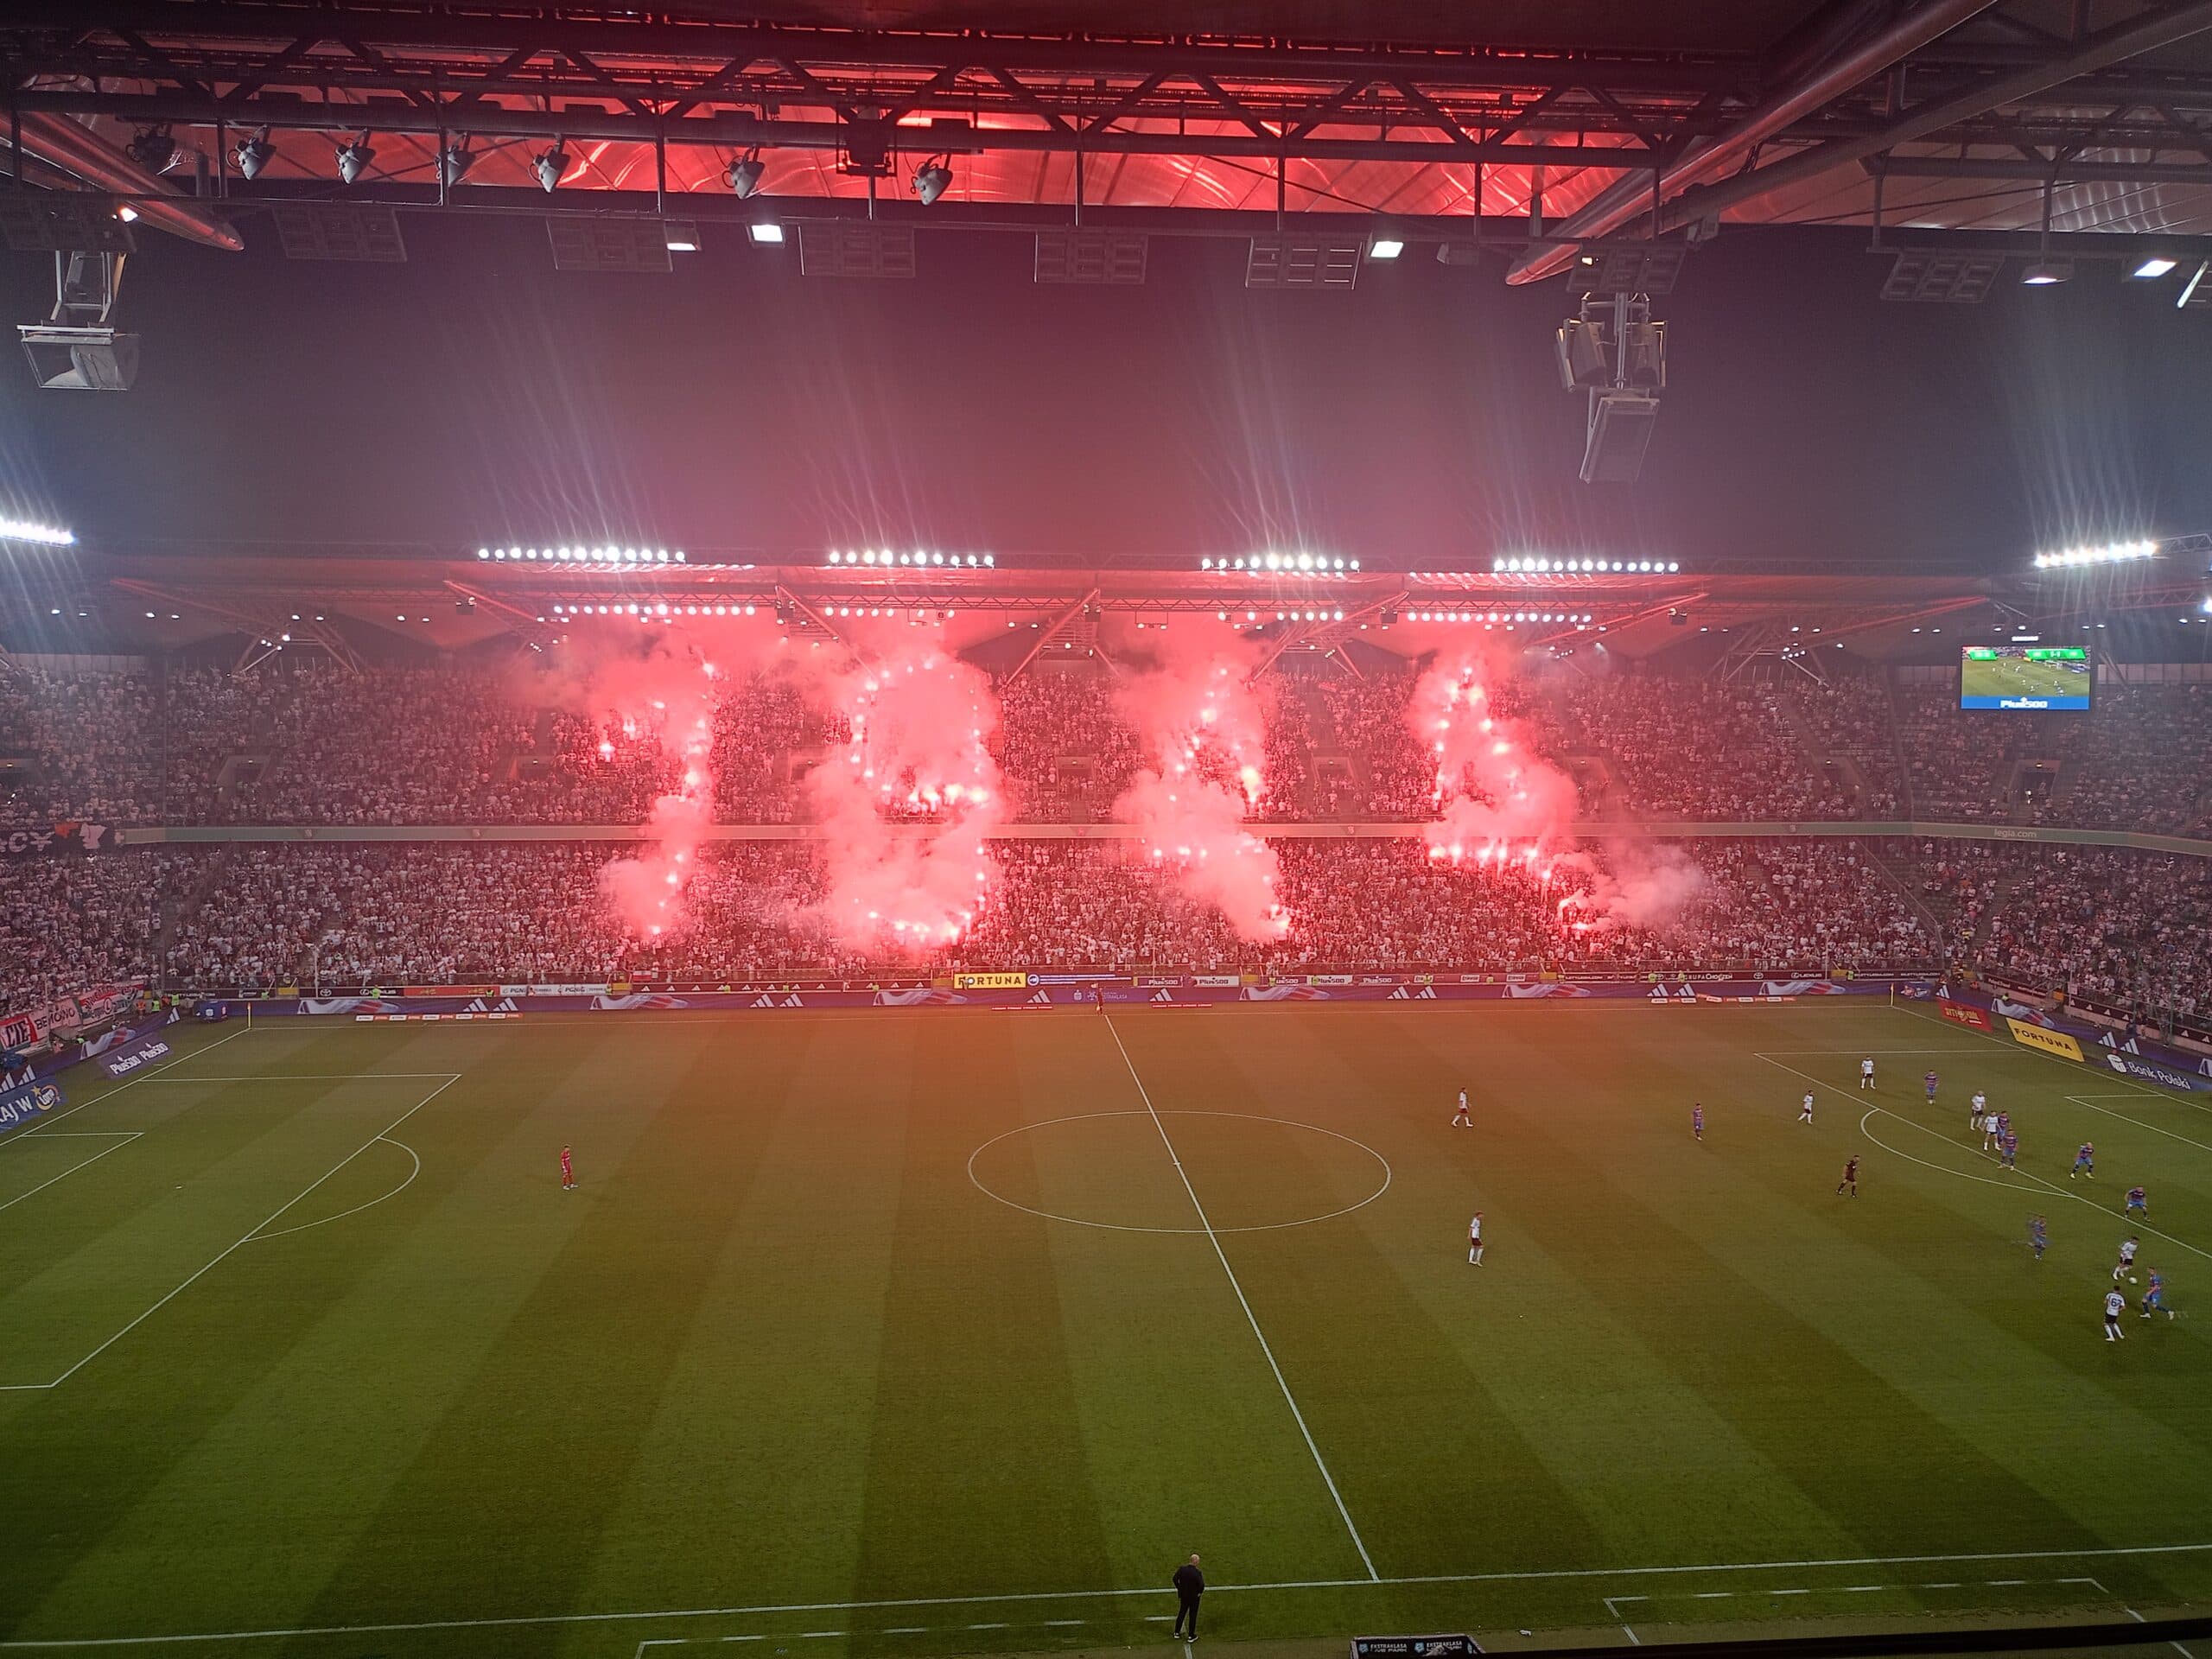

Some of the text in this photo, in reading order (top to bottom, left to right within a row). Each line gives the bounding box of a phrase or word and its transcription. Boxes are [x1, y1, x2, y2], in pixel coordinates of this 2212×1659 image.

[1993, 828, 2037, 838] legia.com
[2014, 1027, 2073, 1052] FORTUNA
[109, 1042, 169, 1075] Plus500 Plus500
[2128, 1061, 2191, 1090] Bank Polski
[15, 1095, 33, 1113] W
